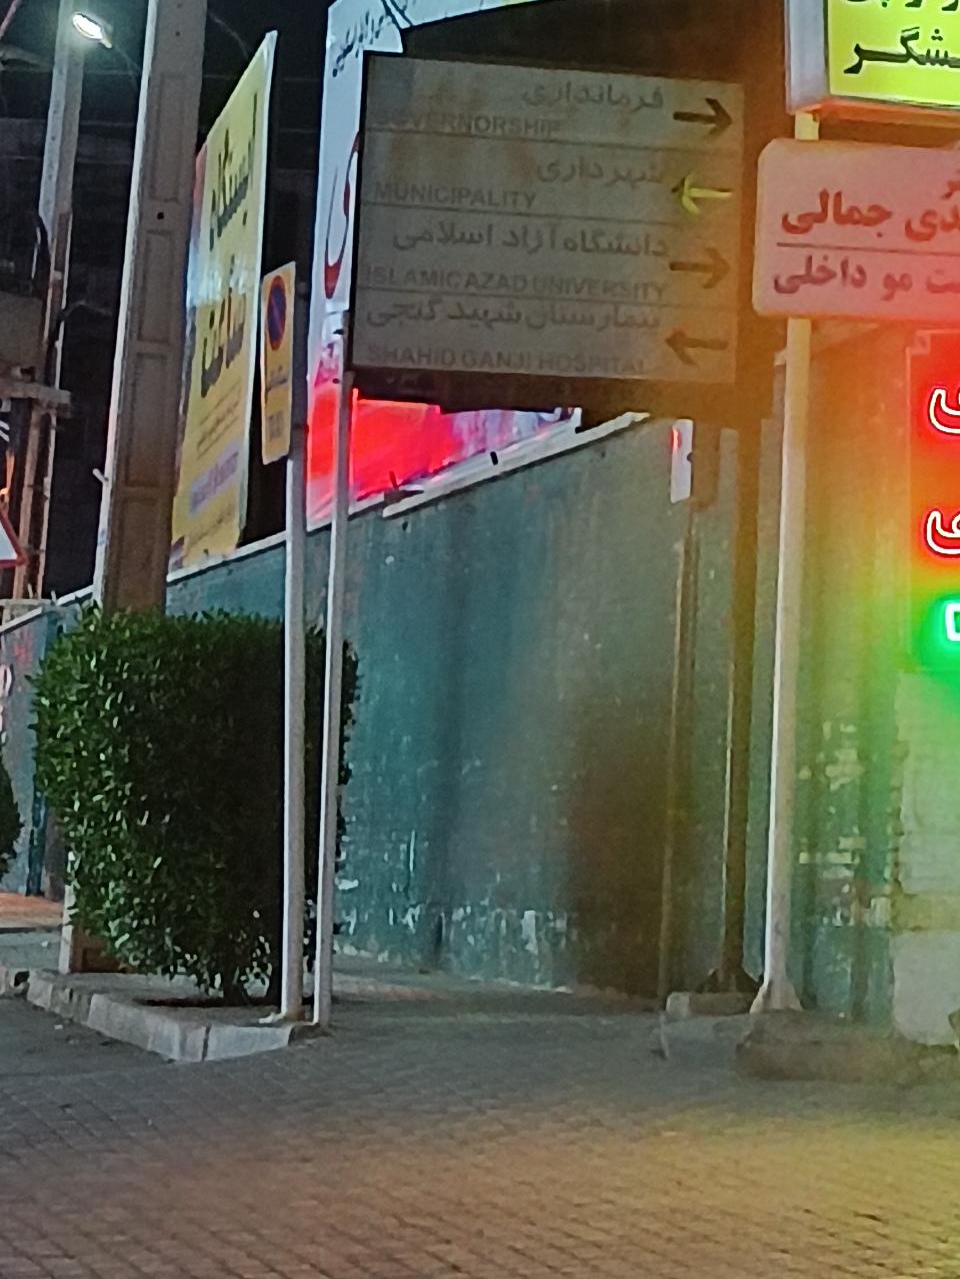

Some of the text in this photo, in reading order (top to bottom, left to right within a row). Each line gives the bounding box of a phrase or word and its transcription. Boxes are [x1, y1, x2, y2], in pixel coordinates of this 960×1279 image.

[523, 80, 665, 113] فرمانداری
[537, 154, 664, 188] شهرداری
[374, 181, 538, 208] MUNICIPALITY
[781, 187, 893, 238] جمالی
[393, 220, 670, 258] دانشگاه آزاد اسلامی
[367, 267, 668, 301] ISLAMIC AZAD UNIVERSITY
[773, 254, 867, 294] داخلی
[881, 272, 913, 301] مو
[448, 297, 523, 327] شهید
[368, 344, 644, 374] SHAHID GANJI HOSPITAL
